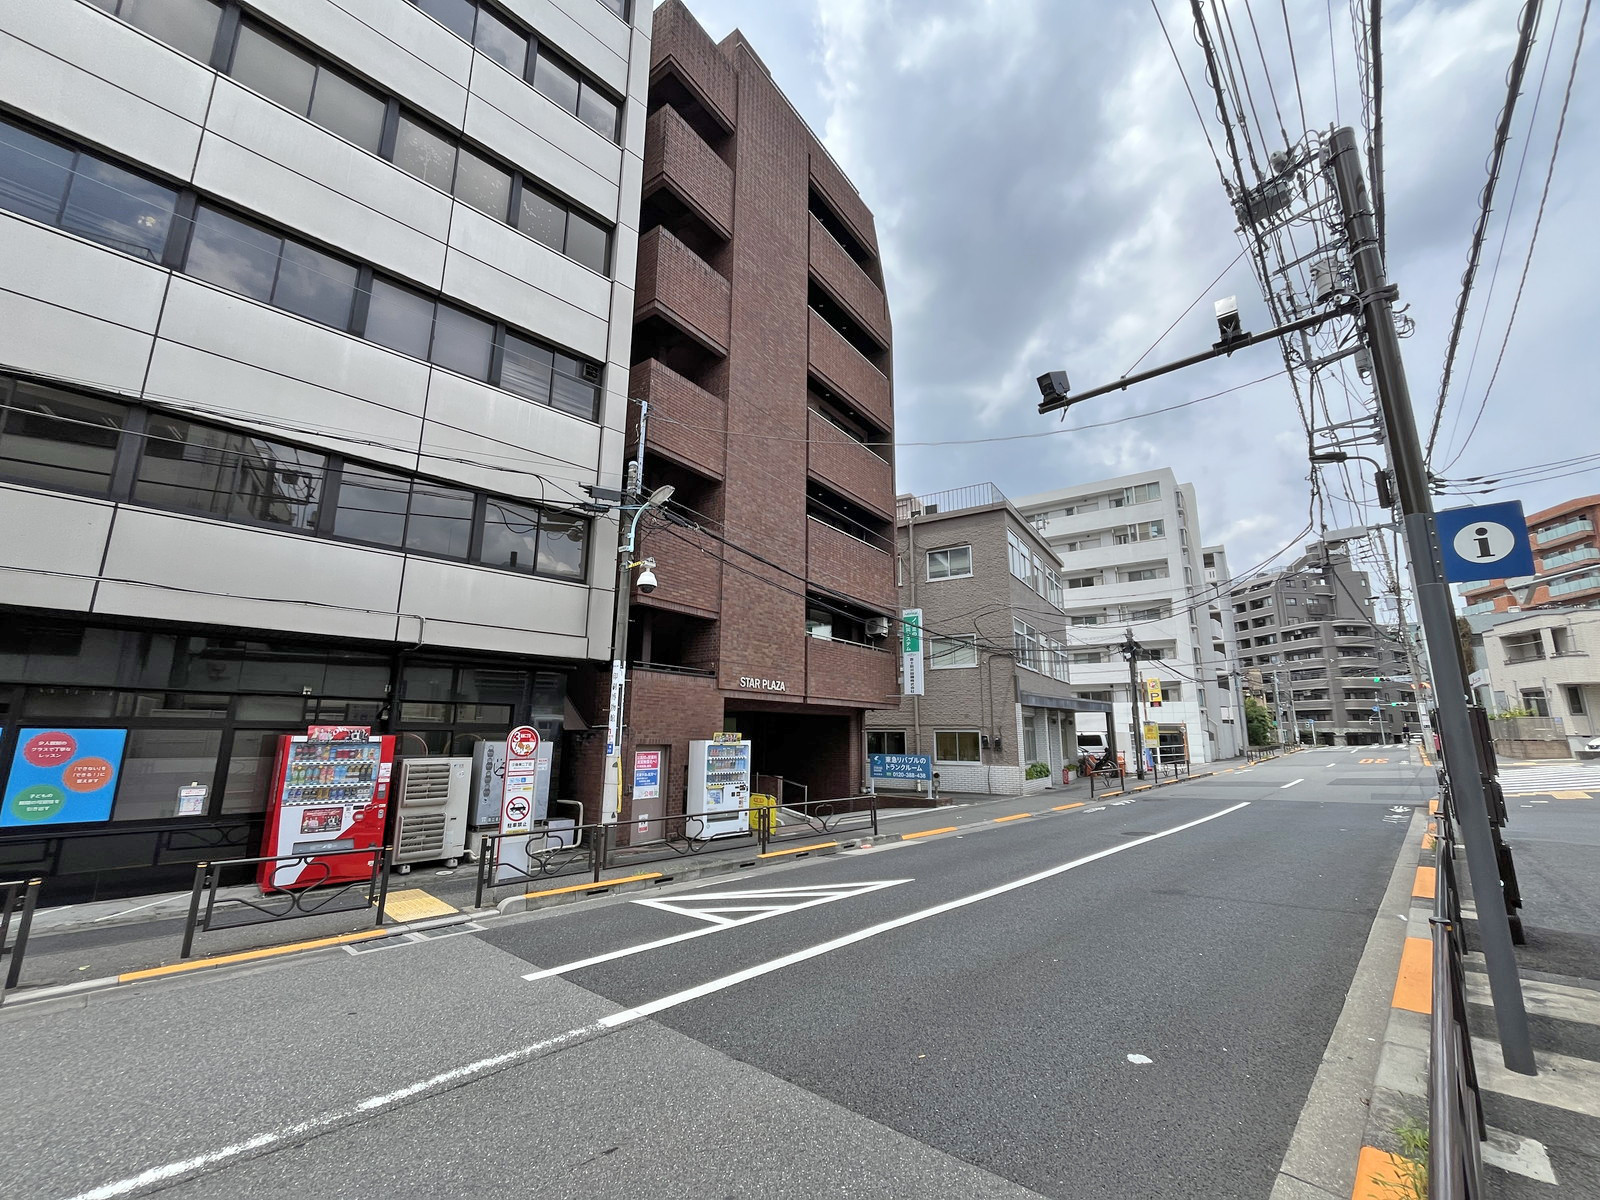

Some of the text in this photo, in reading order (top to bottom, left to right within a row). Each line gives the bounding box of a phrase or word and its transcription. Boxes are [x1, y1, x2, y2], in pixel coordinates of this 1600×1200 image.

[740, 676, 786, 692] STAR PLAZA
[1150, 692, 1160, 701] P
[513, 731, 520, 742] 3
[885, 756, 927, 765] 東急リバブルの
[885, 764, 923, 772] トランクルーム
